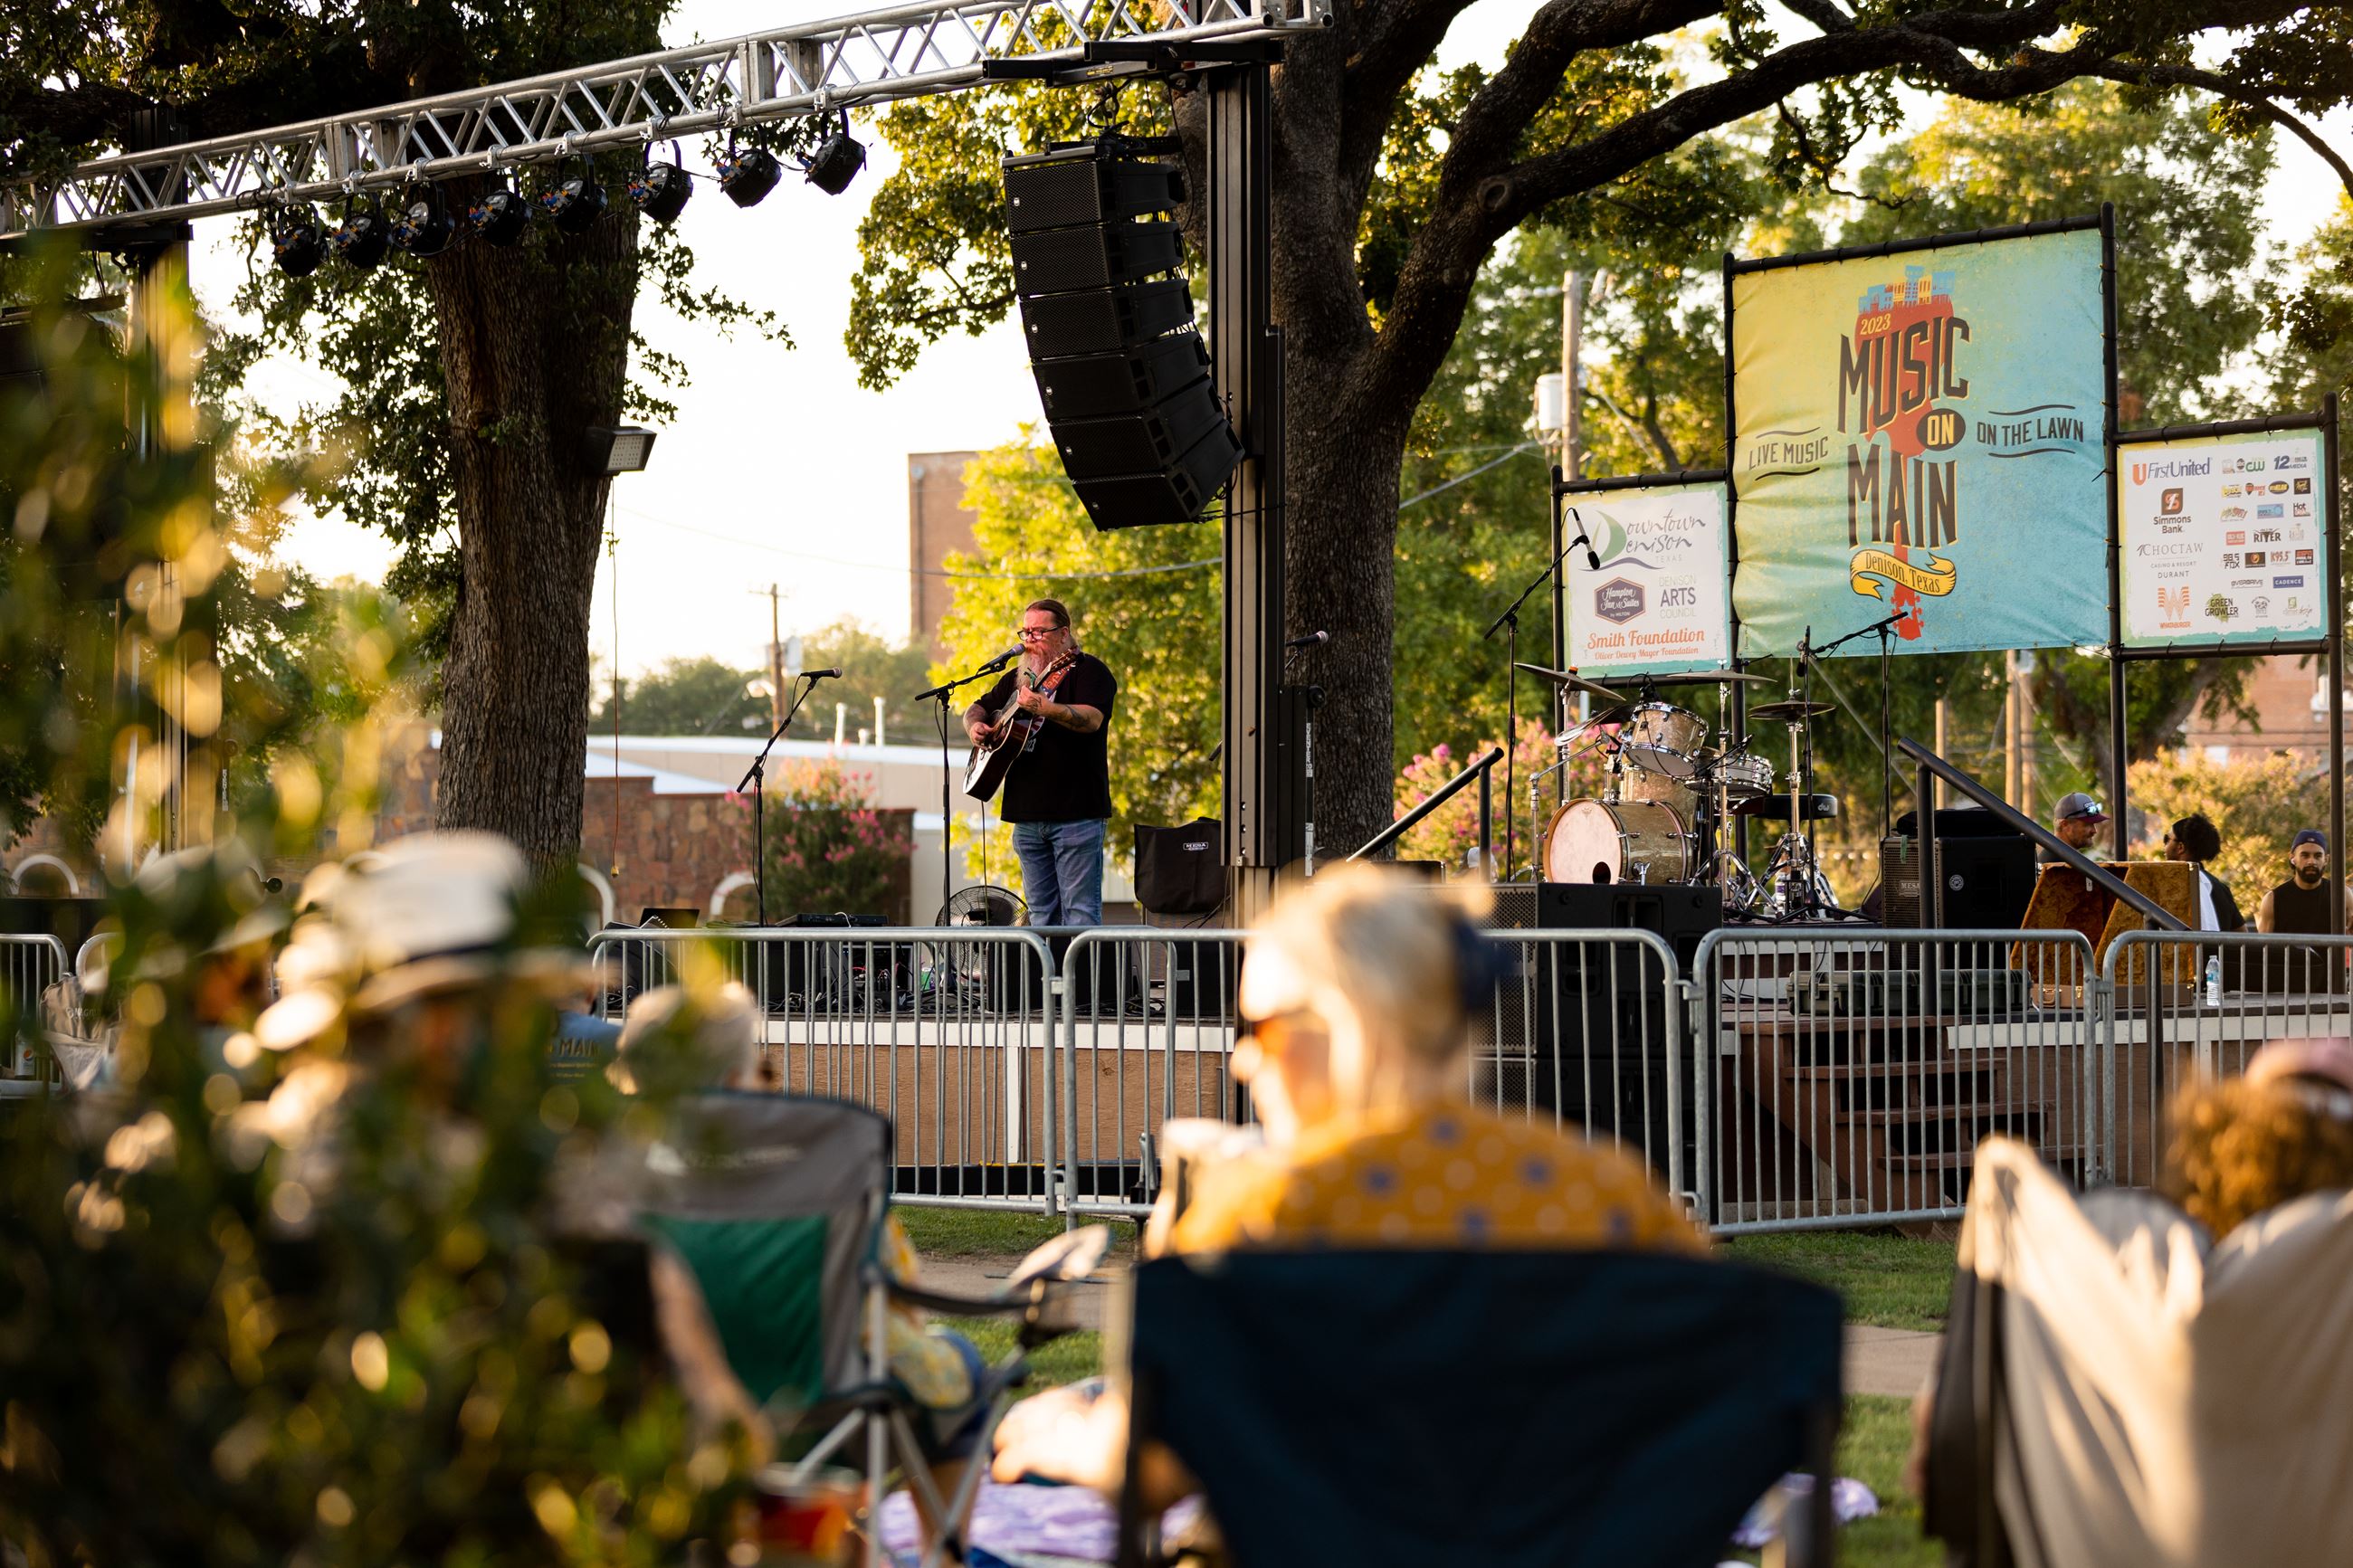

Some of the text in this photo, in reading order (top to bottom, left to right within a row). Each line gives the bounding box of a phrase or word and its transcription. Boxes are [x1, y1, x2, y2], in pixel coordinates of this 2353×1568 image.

[1860, 313, 1891, 336] 2023
[1837, 317, 1971, 436] MUSIC
[1927, 413, 1955, 446] ON
[1977, 417, 2084, 447] ON THE LAWN
[1748, 436, 1829, 470] LIVE MUSIC
[2273, 455, 2290, 470] 12
[1847, 442, 1958, 550] MAIN
[2153, 516, 2192, 526] Simmons
[2162, 525, 2183, 534] Bank
[2253, 531, 2282, 543] RIVER
[2143, 542, 2204, 556] CHOCTAW
[1864, 552, 1941, 594] Denison, Texas
[2158, 570, 2190, 579] DURANT
[1659, 574, 1696, 587] DENISON
[1602, 587, 1636, 601] Hampton
[1660, 586, 1697, 607] ARTS
[2210, 598, 2234, 608] GREEN
[1660, 607, 1697, 619] COUNCIL
[2205, 607, 2239, 617] GROWLER
[1587, 627, 1705, 650] Smith Foundation
[1661, 647, 1699, 656] Foundation
